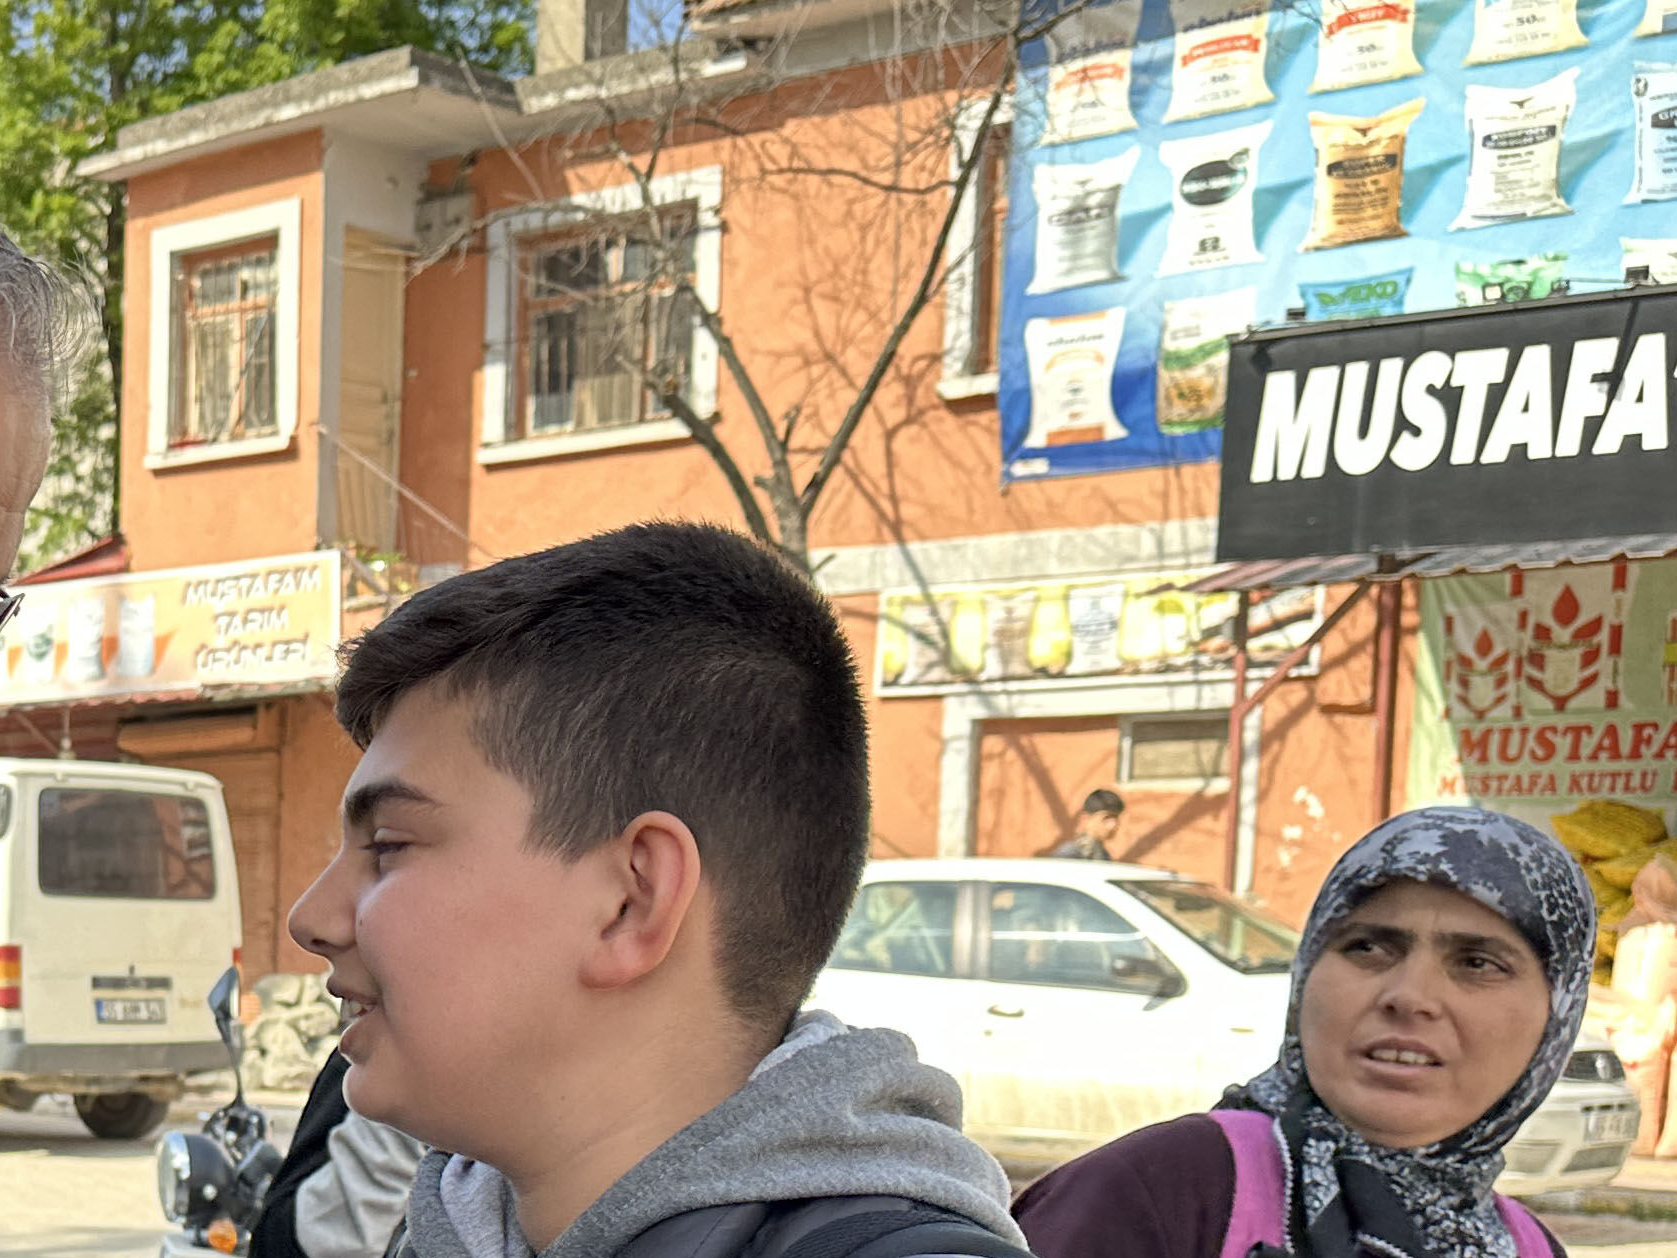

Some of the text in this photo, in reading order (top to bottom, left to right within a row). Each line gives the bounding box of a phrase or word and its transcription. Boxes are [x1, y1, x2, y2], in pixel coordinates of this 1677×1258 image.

[1249, 331, 1677, 485] MUSTAFA
[212, 603, 290, 635] TARIM
[1437, 772, 1557, 797] MUSTAFA
[1568, 768, 1659, 796] KUTLU
